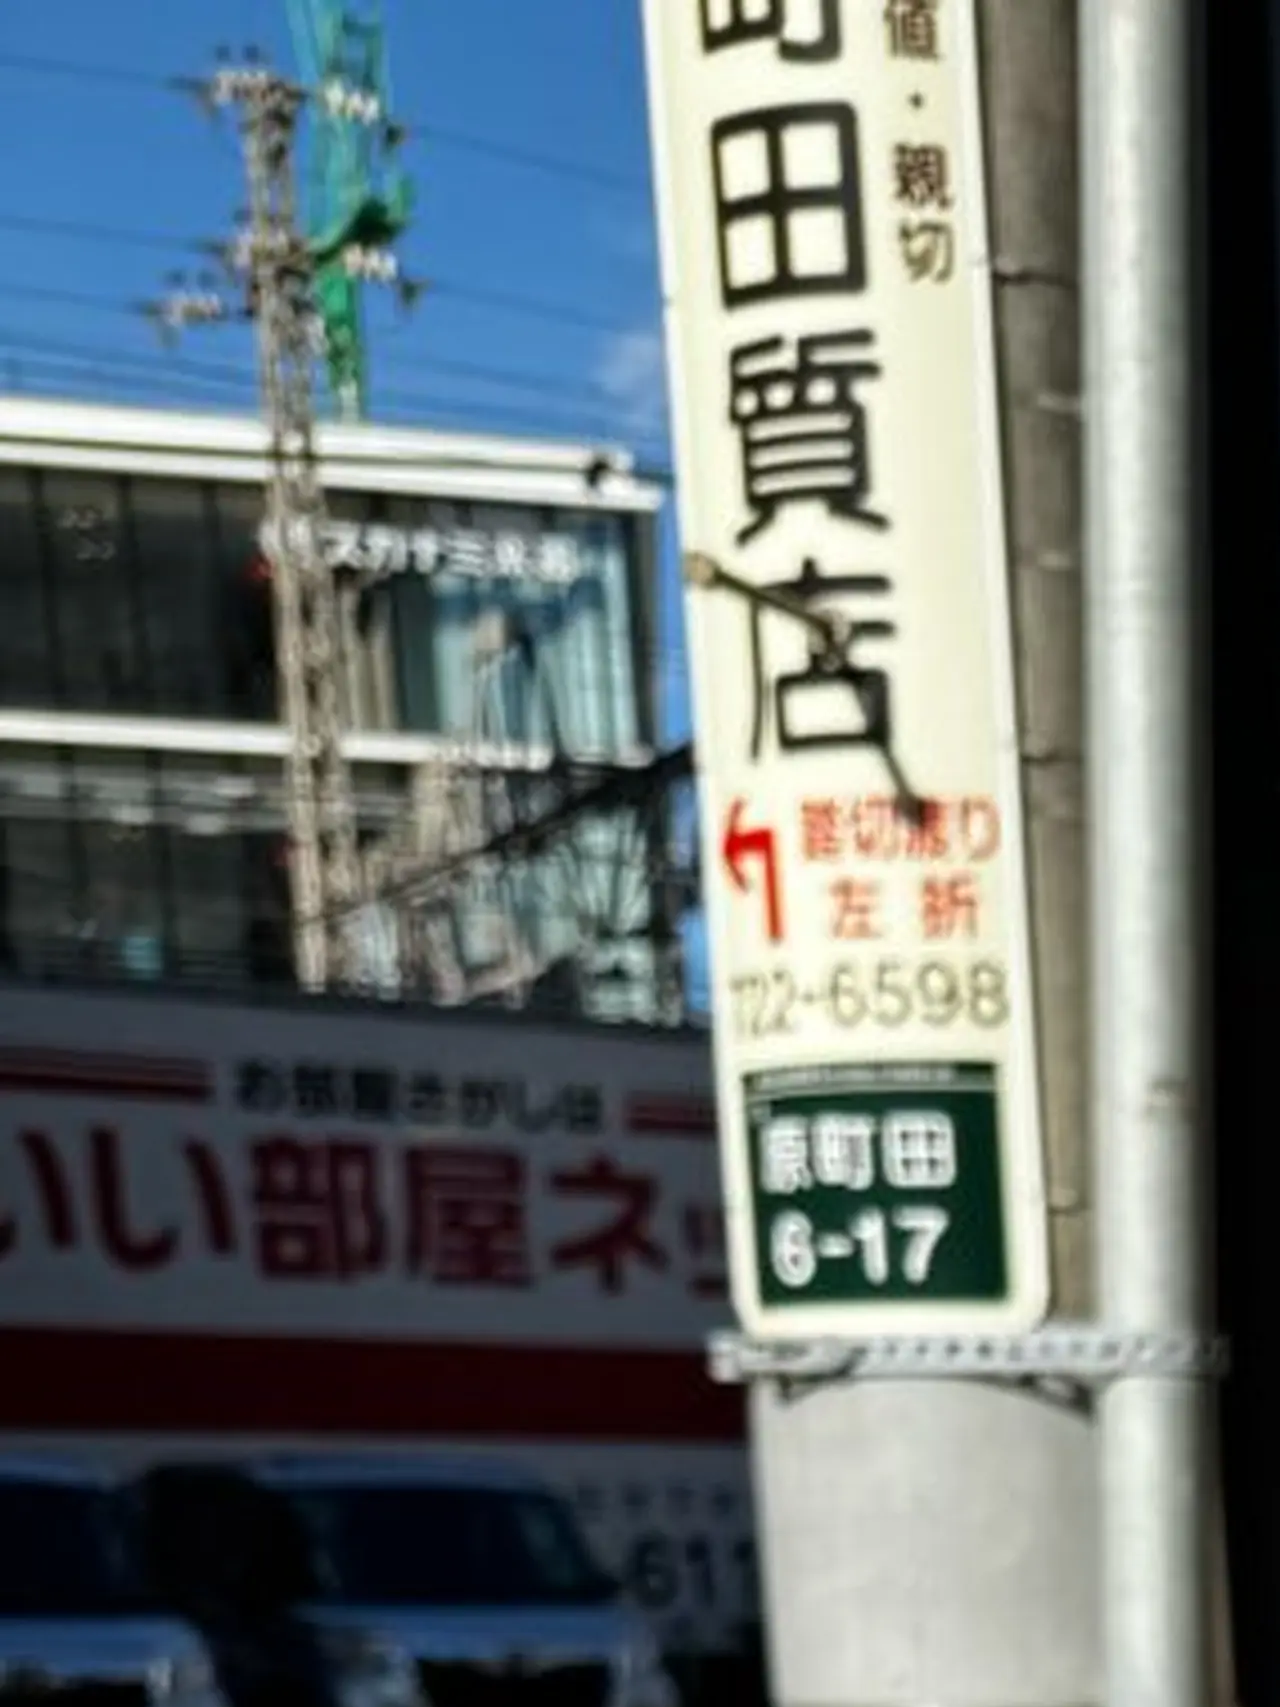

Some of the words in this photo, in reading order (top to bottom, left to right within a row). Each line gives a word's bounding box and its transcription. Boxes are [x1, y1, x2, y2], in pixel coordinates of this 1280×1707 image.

[829, 874, 980, 941] 左折
[758, 1108, 957, 1194] 原町田
[769, 1204, 950, 1288] 6-17
